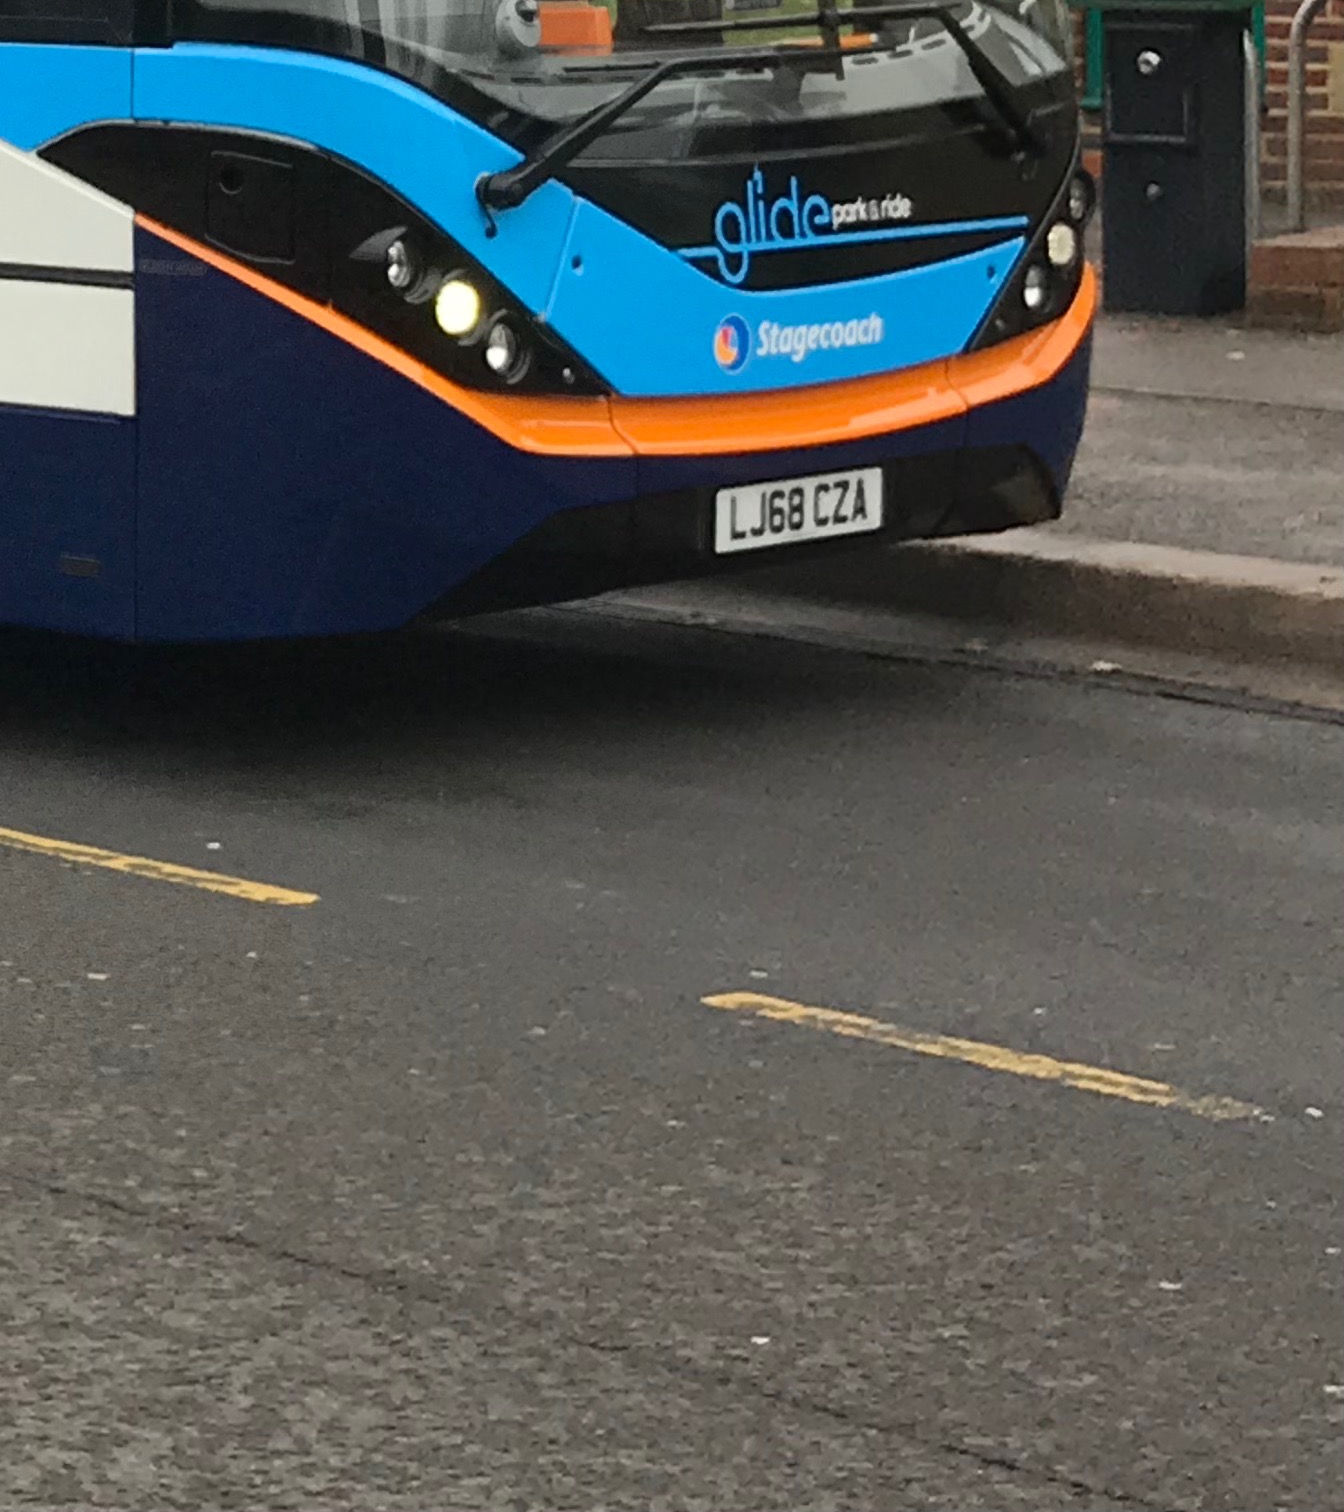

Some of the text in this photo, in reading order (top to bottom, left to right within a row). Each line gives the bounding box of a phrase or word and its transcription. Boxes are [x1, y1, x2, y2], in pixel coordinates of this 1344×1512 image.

[714, 161, 830, 284] glide
[832, 196, 867, 231] park
[881, 192, 912, 219] ride
[756, 312, 884, 363] Stagecoach
[729, 477, 868, 541] LJ68 CZA
